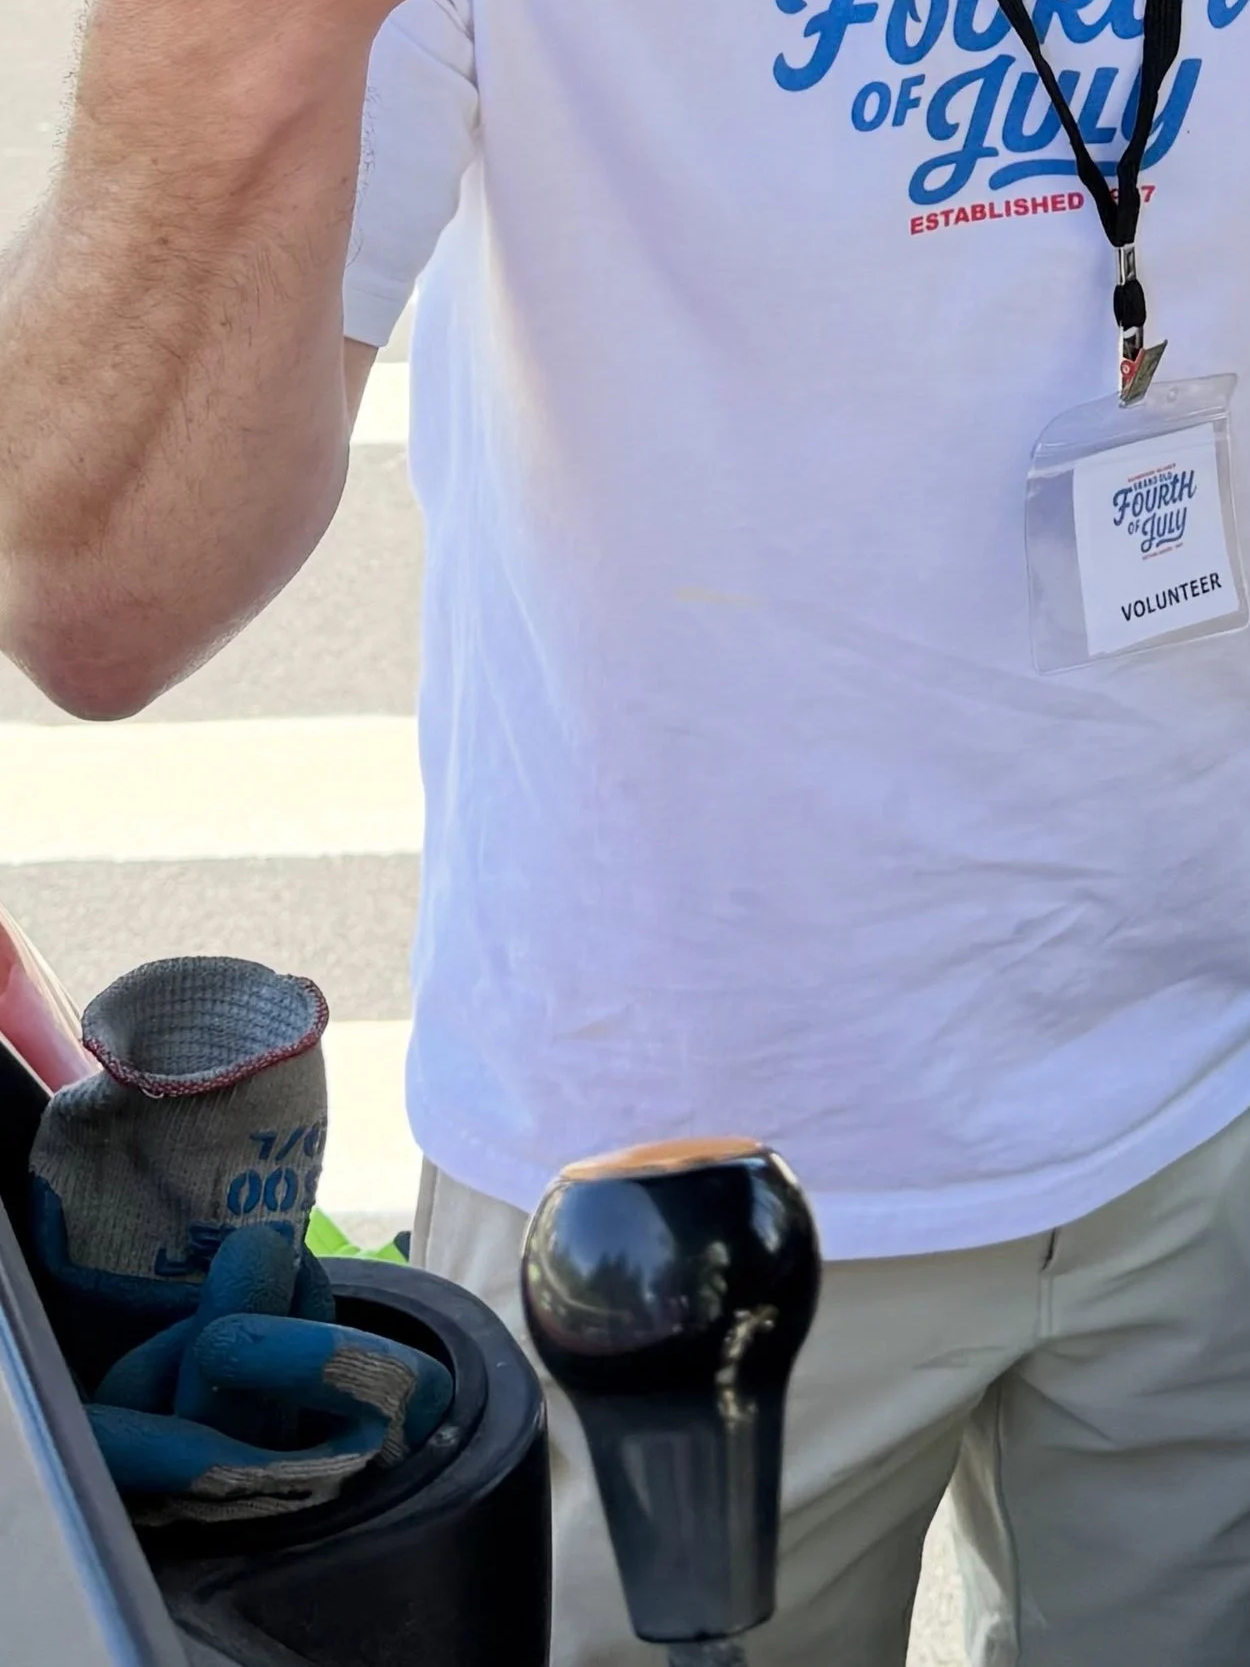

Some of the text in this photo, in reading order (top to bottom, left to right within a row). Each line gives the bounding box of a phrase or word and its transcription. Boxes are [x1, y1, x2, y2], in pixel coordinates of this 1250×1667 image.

[851, 54, 1202, 205] OF JULY
[910, 191, 1085, 235] ESTABLISHED
[1113, 470, 1197, 526] FOURTH
[1128, 518, 1141, 535] OF
[1141, 507, 1187, 553] JULY
[1121, 572, 1222, 621] VOLUNTEER
